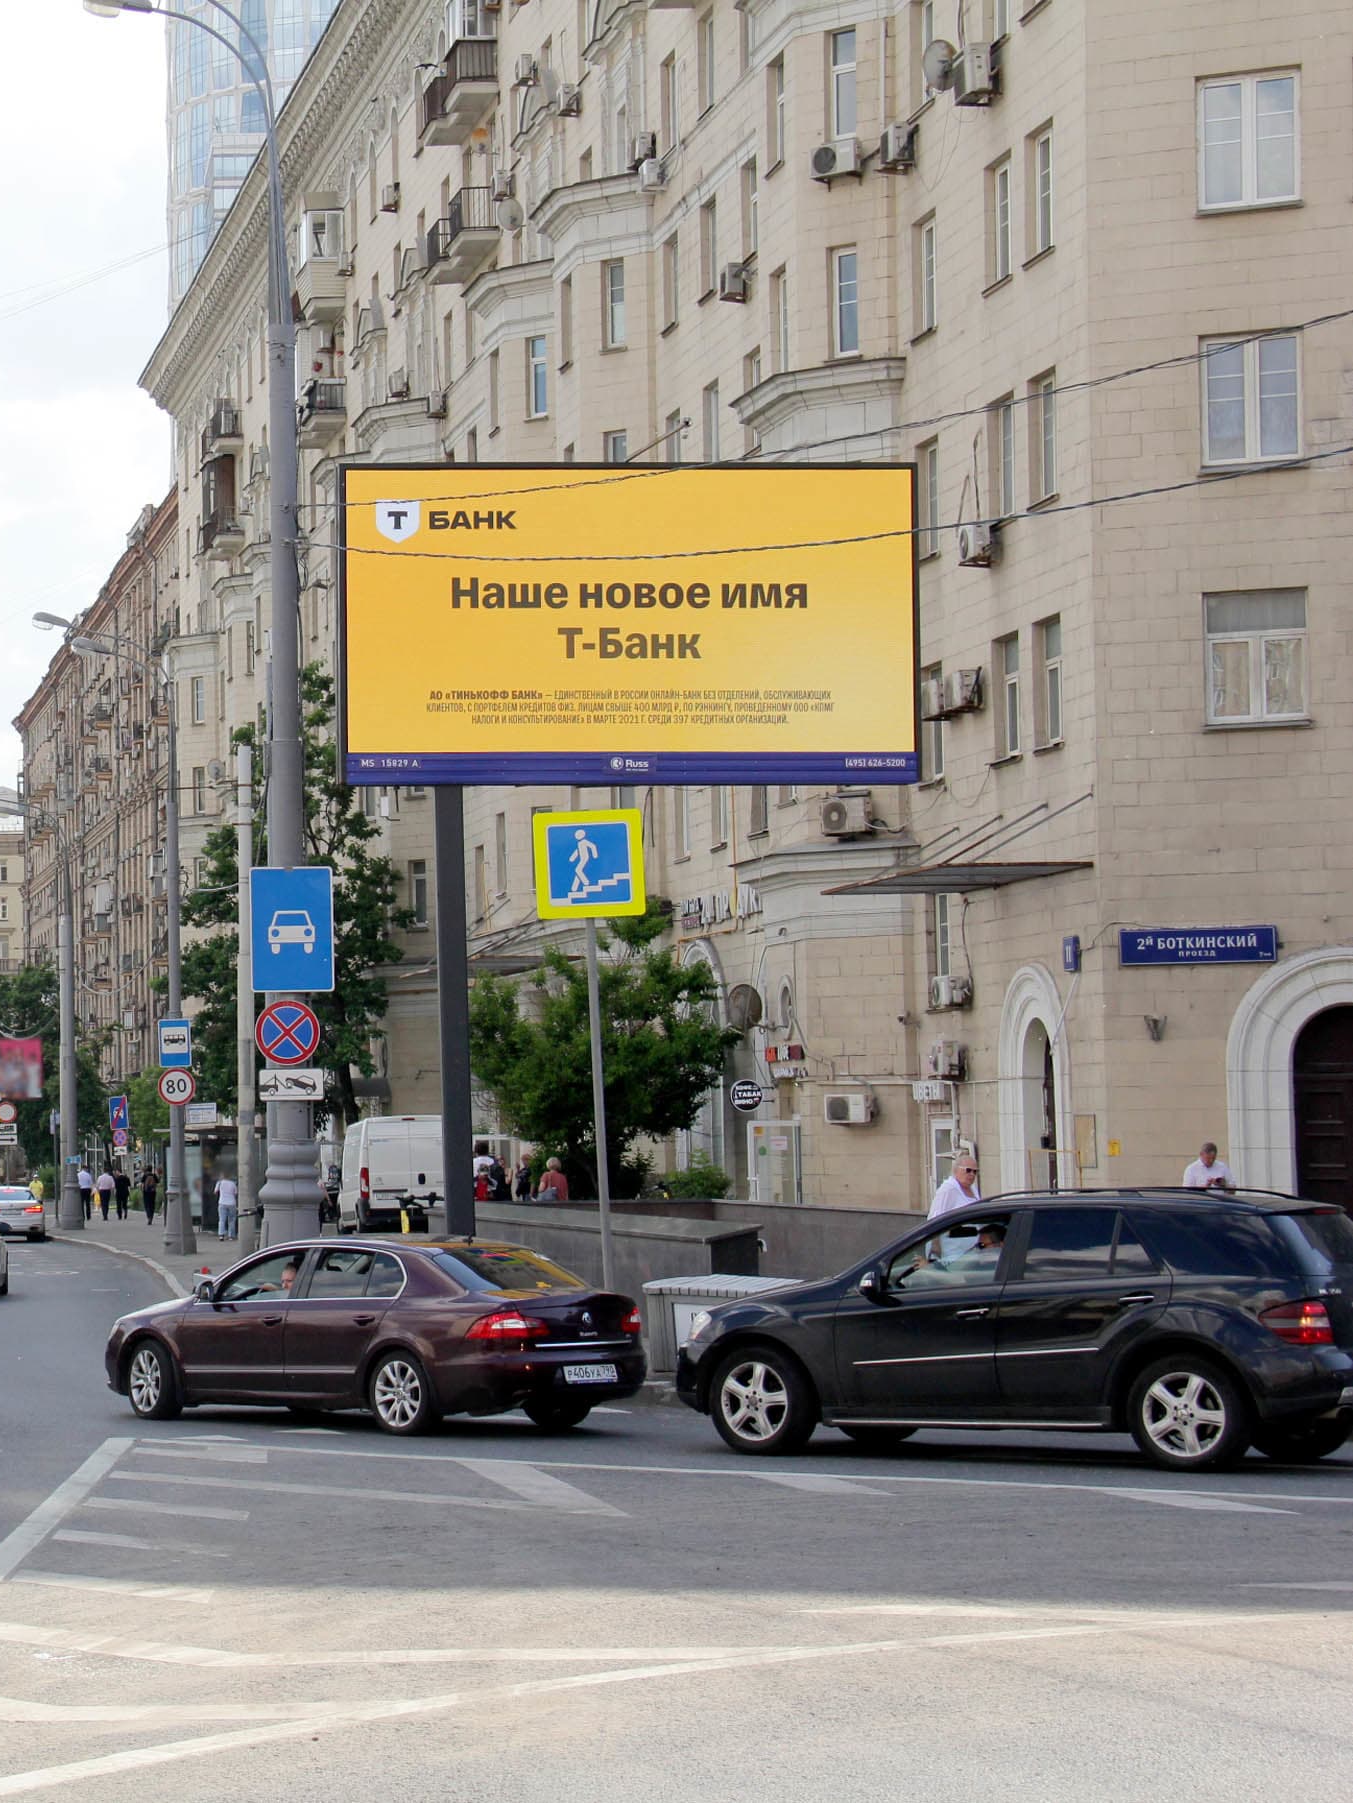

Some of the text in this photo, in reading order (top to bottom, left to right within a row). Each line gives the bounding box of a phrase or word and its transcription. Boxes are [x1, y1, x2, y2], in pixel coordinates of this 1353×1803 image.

[387, 511, 517, 530] Т БАНК
[451, 577, 809, 609] Наше новое имя
[557, 627, 702, 659] Т-Банк
[430, 690, 443, 700] АО
[445, 690, 509, 700] «ТИНЬКОФФ
[511, 690, 543, 700] БАНК»
[554, 688, 612, 701] ЕДИНСТВЕННЫЙ
[614, 690, 619, 700] В
[620, 690, 648, 700] РОССИИ
[650, 688, 701, 700] ОНЛАЙН-БАНК
[703, 690, 716, 700] БЕЗ
[717, 688, 762, 702] ОТДЕЛЕНИЙ,
[763, 690, 832, 702] ОБСЛУЖИВАЮЩИХ
[426, 702, 466, 713] КЛИЕНТОВ,
[468, 702, 472, 712] С
[474, 702, 517, 712] ПОРТФЕЛЕМ
[519, 702, 556, 713] КРЕДИТОВ
[578, 702, 604, 713] ЛИЦАМ
[605, 702, 632, 712] СВЫШЕ
[634, 702, 650, 712] 400
[652, 702, 672, 713] МЛРД
[683, 702, 693, 712] ПО
[695, 702, 733, 713] РЭНКИНГУ,
[734, 702, 792, 713] ПРОВЕДЕННОМУ
[793, 702, 809, 712] ООО
[471, 715, 500, 725] НАЛОГИ
[501, 715, 507, 724] И
[508, 715, 584, 725] КОНСУЛЬТИРОВАНИЕ»
[586, 715, 592, 724] В
[593, 715, 617, 724] МАРТЕ
[618, 715, 640, 724] 2021
[648, 715, 672, 725] СРЕДИ
[673, 715, 689, 724] 397
[690, 715, 734, 726] КРЕДИТНЫХ
[736, 713, 790, 725] ОРГАНИЗАЦИЙ.
[361, 759, 375, 768] MS
[625, 759, 649, 768] Russ
[867, 758, 906, 768] 626-5200
[1157, 932, 1257, 950] БОТКИНСКИЙ
[166, 1078, 187, 1094] 80
[737, 1090, 762, 1098] ТАБАК
